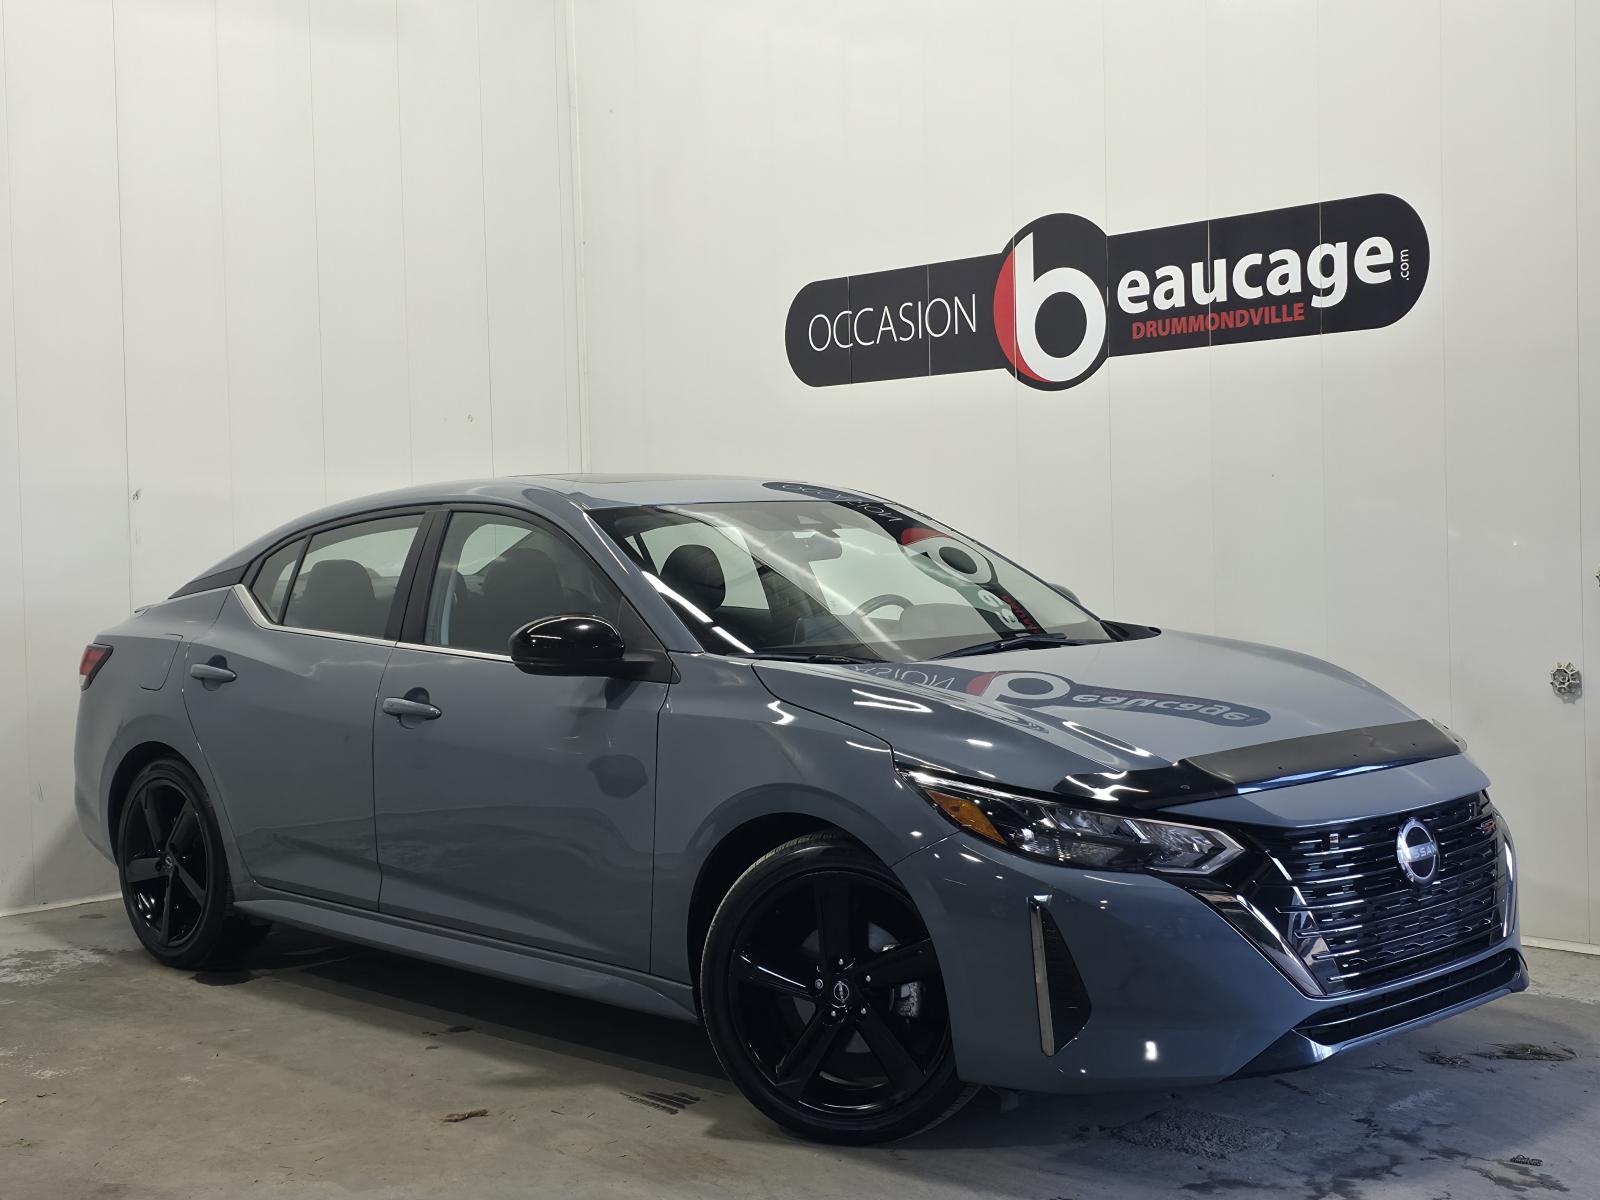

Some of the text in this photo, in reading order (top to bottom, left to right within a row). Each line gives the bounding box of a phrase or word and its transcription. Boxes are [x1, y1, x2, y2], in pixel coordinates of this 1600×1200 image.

[1400, 249, 1410, 281] .com
[808, 294, 976, 351] OCCASION
[1132, 302, 1305, 340] DRUMMONDVILLE
